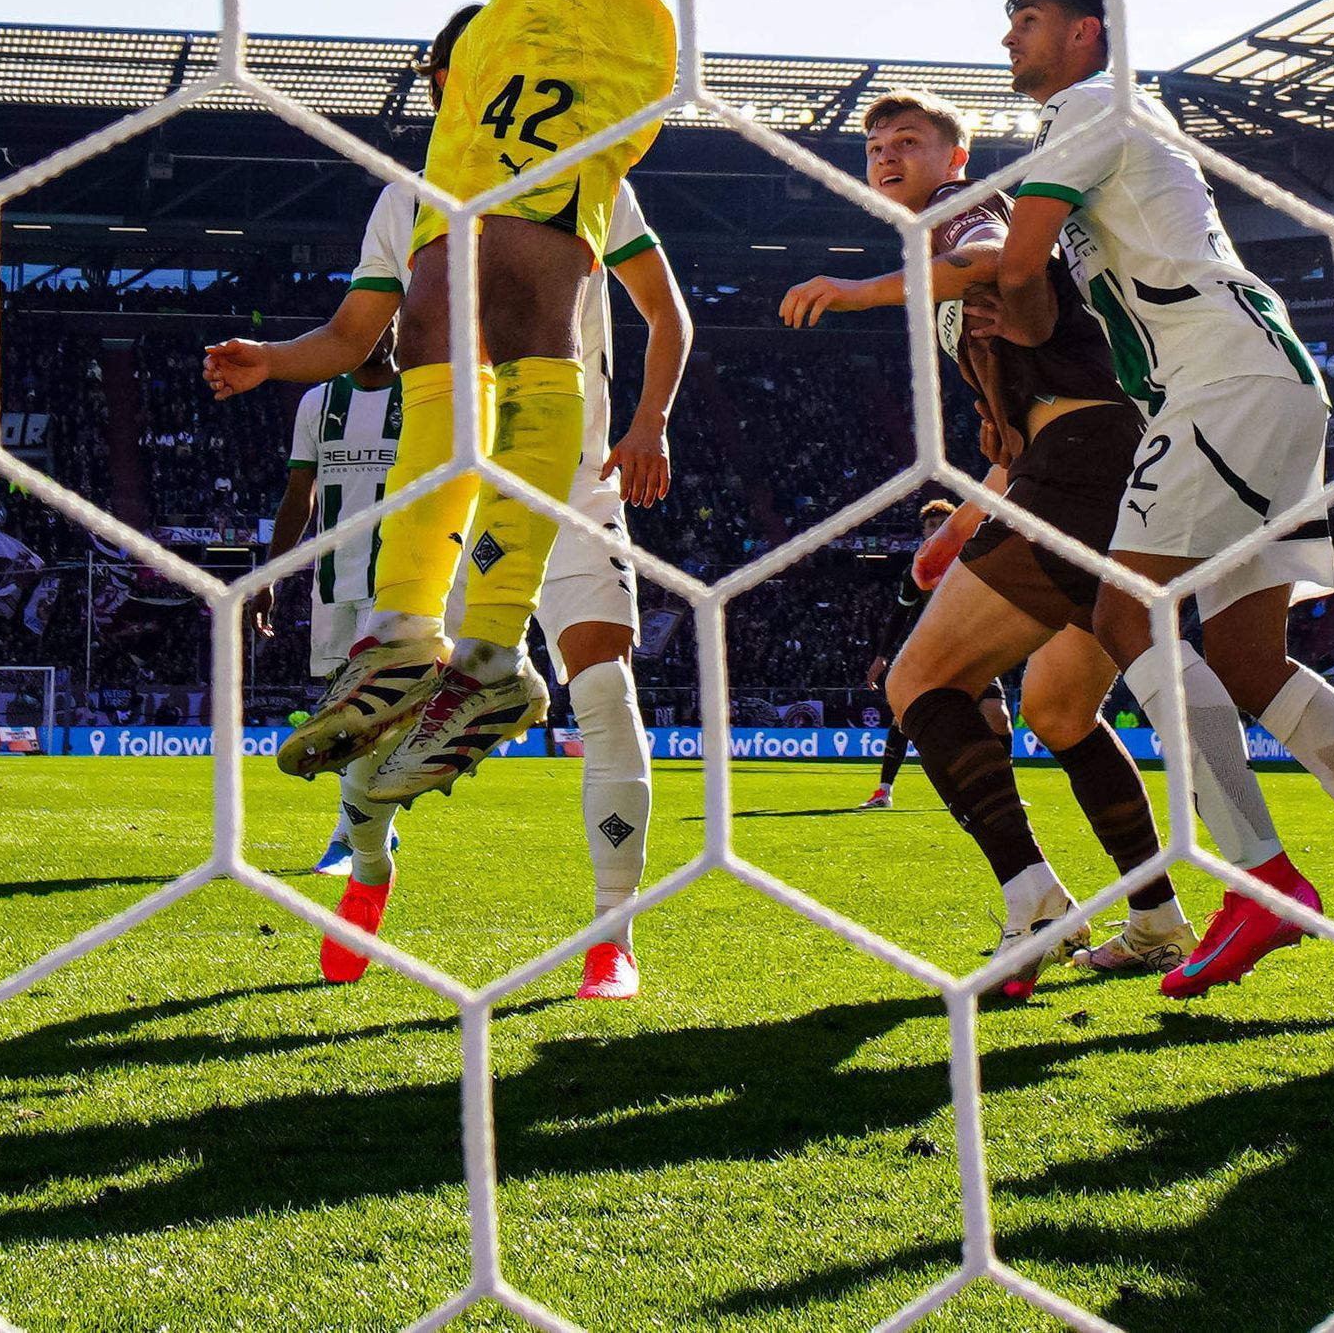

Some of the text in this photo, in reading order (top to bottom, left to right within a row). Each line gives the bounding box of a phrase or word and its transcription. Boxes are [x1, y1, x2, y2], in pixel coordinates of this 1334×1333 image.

[480, 75, 574, 152] 42
[948, 215, 986, 241] ASTRA
[323, 450, 397, 462] REUTE
[1131, 435, 1171, 491] 2
[118, 730, 277, 756] followod
[668, 732, 817, 757] folwfood
